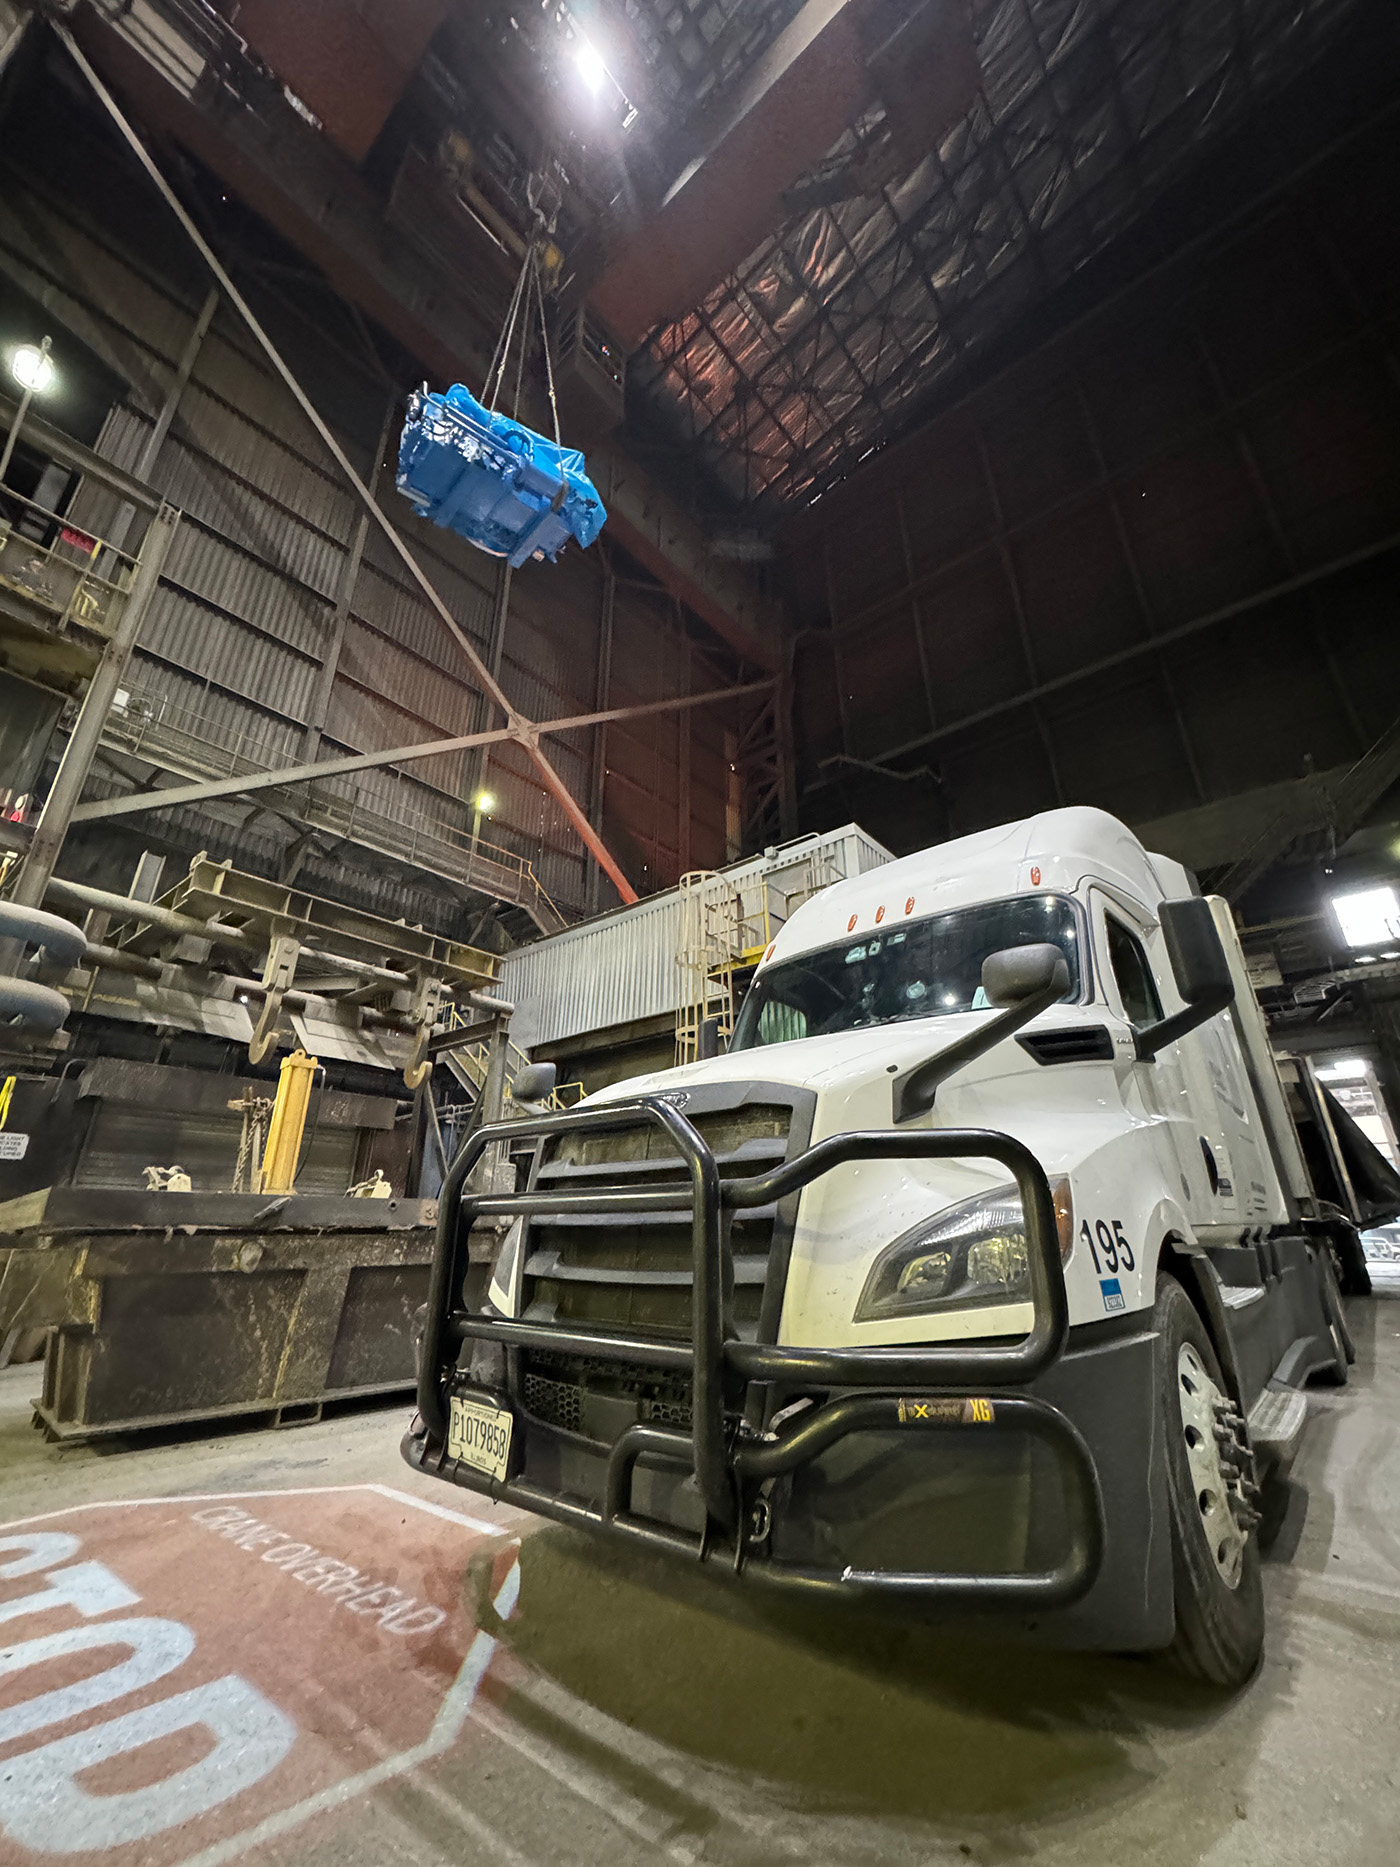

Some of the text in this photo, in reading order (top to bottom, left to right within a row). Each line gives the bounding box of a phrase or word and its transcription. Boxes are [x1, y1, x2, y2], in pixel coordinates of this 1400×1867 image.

[1080, 1219, 1135, 1274] 195
[453, 1411, 506, 1460] P1079858
[969, 1399, 991, 1421] XG
[191, 1506, 447, 1635] CRANE OVERHEAD
